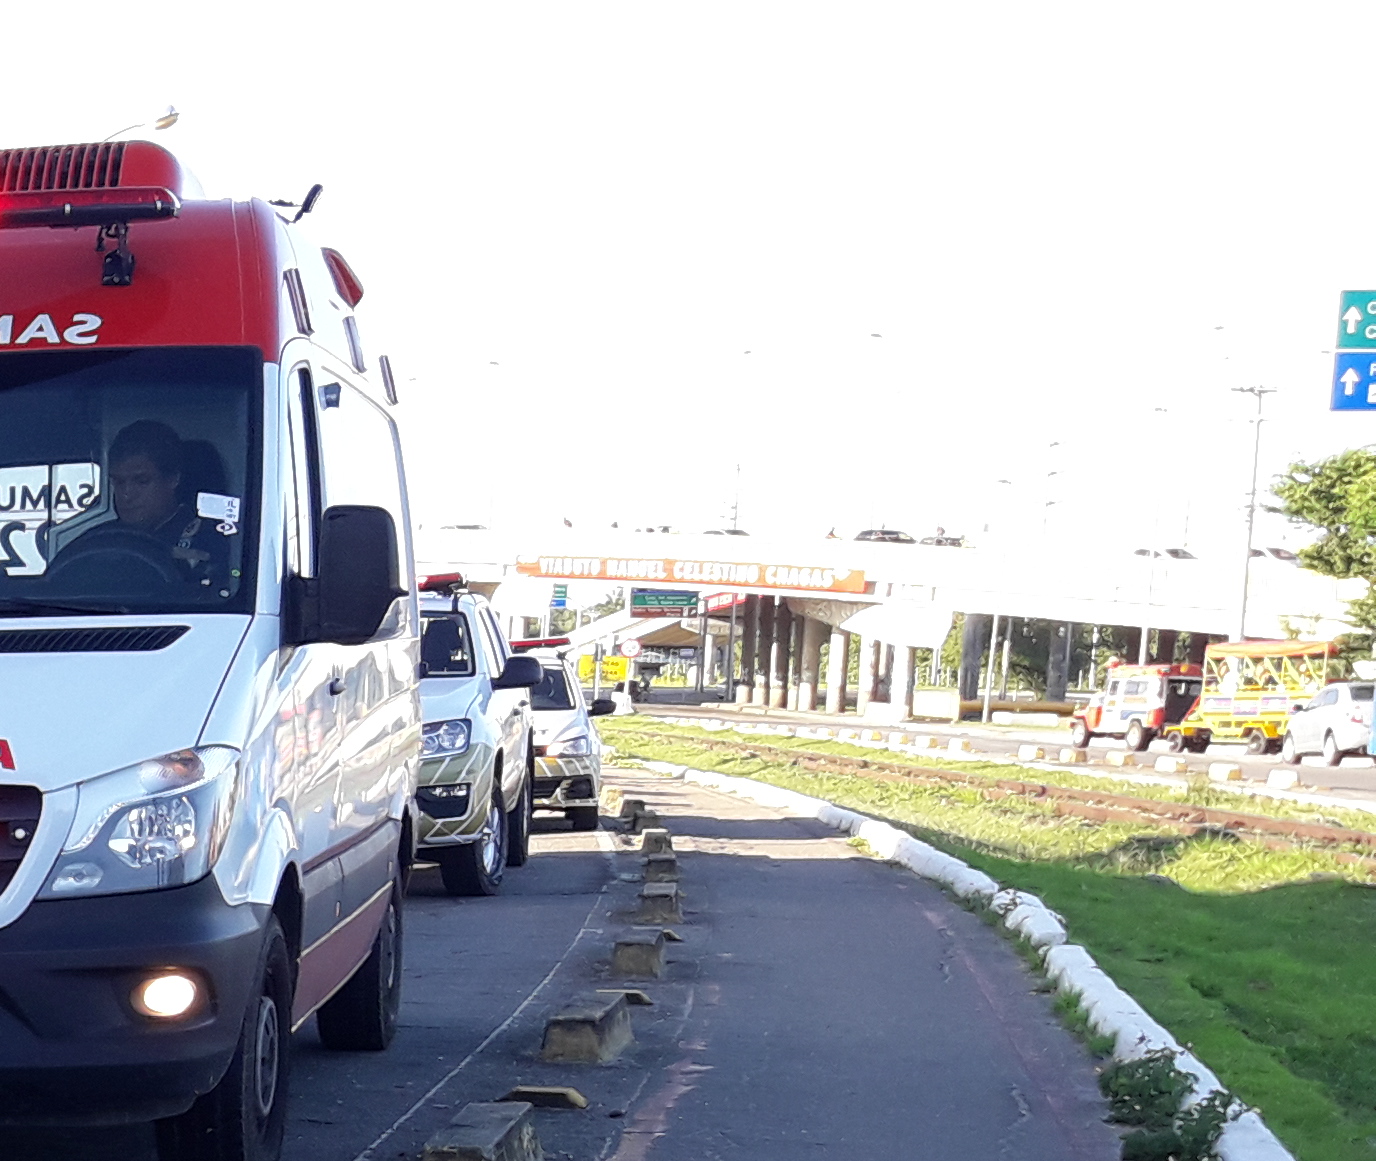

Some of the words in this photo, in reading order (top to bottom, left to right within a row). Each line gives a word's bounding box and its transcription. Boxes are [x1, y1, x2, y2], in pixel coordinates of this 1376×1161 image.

[538, 557, 600, 576] VIADUTO
[673, 561, 758, 583] CELESTINO
[765, 565, 835, 588] CHAGAS
